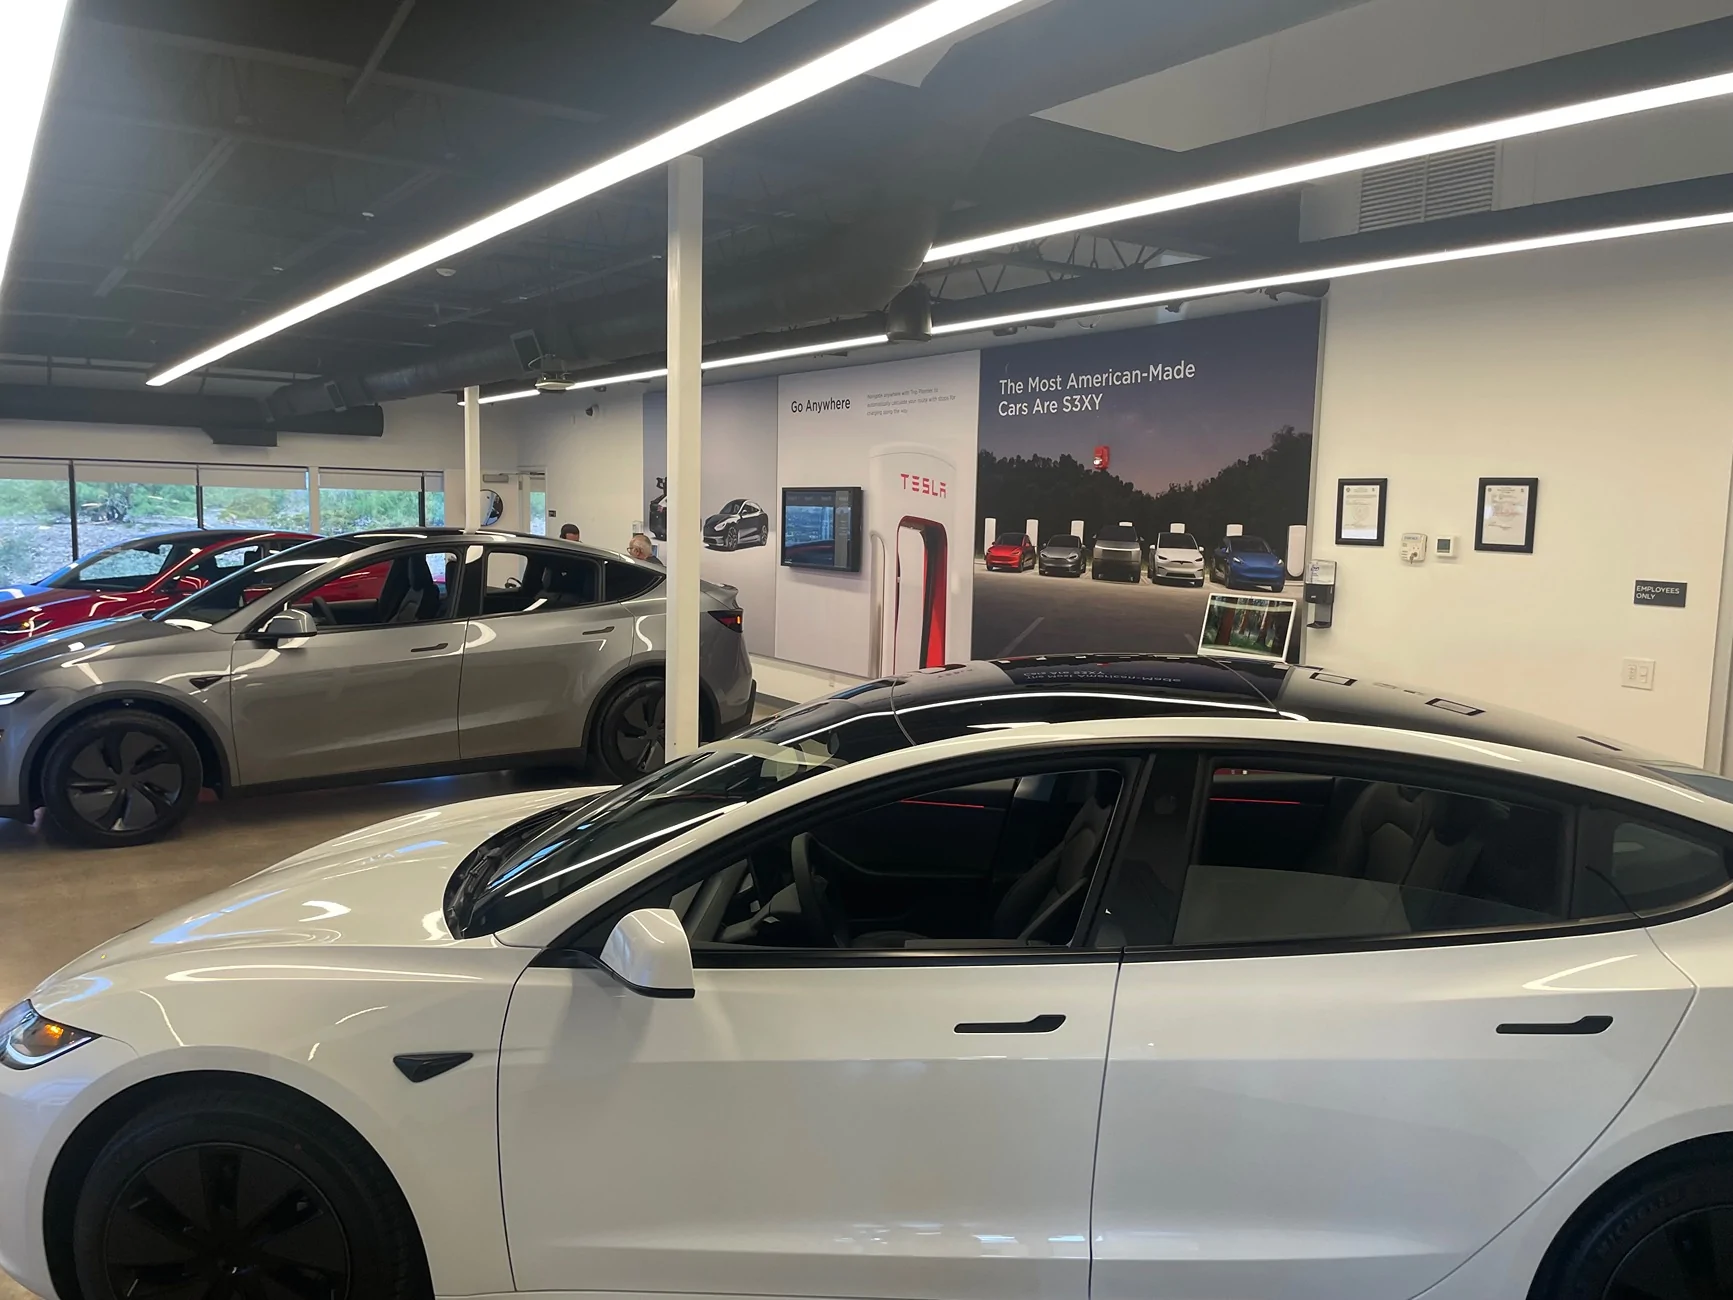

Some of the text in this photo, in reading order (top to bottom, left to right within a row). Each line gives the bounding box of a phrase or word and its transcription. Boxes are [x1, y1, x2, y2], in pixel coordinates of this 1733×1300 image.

[999, 360, 1196, 395] The Most American-Made
[791, 396, 851, 414] Go Anywhere
[998, 393, 1103, 416] Cars Are S3XY
[900, 473, 947, 499] TESLA
[1635, 592, 1656, 600] ONLY
[1636, 585, 1680, 595] EMPLOYEES
